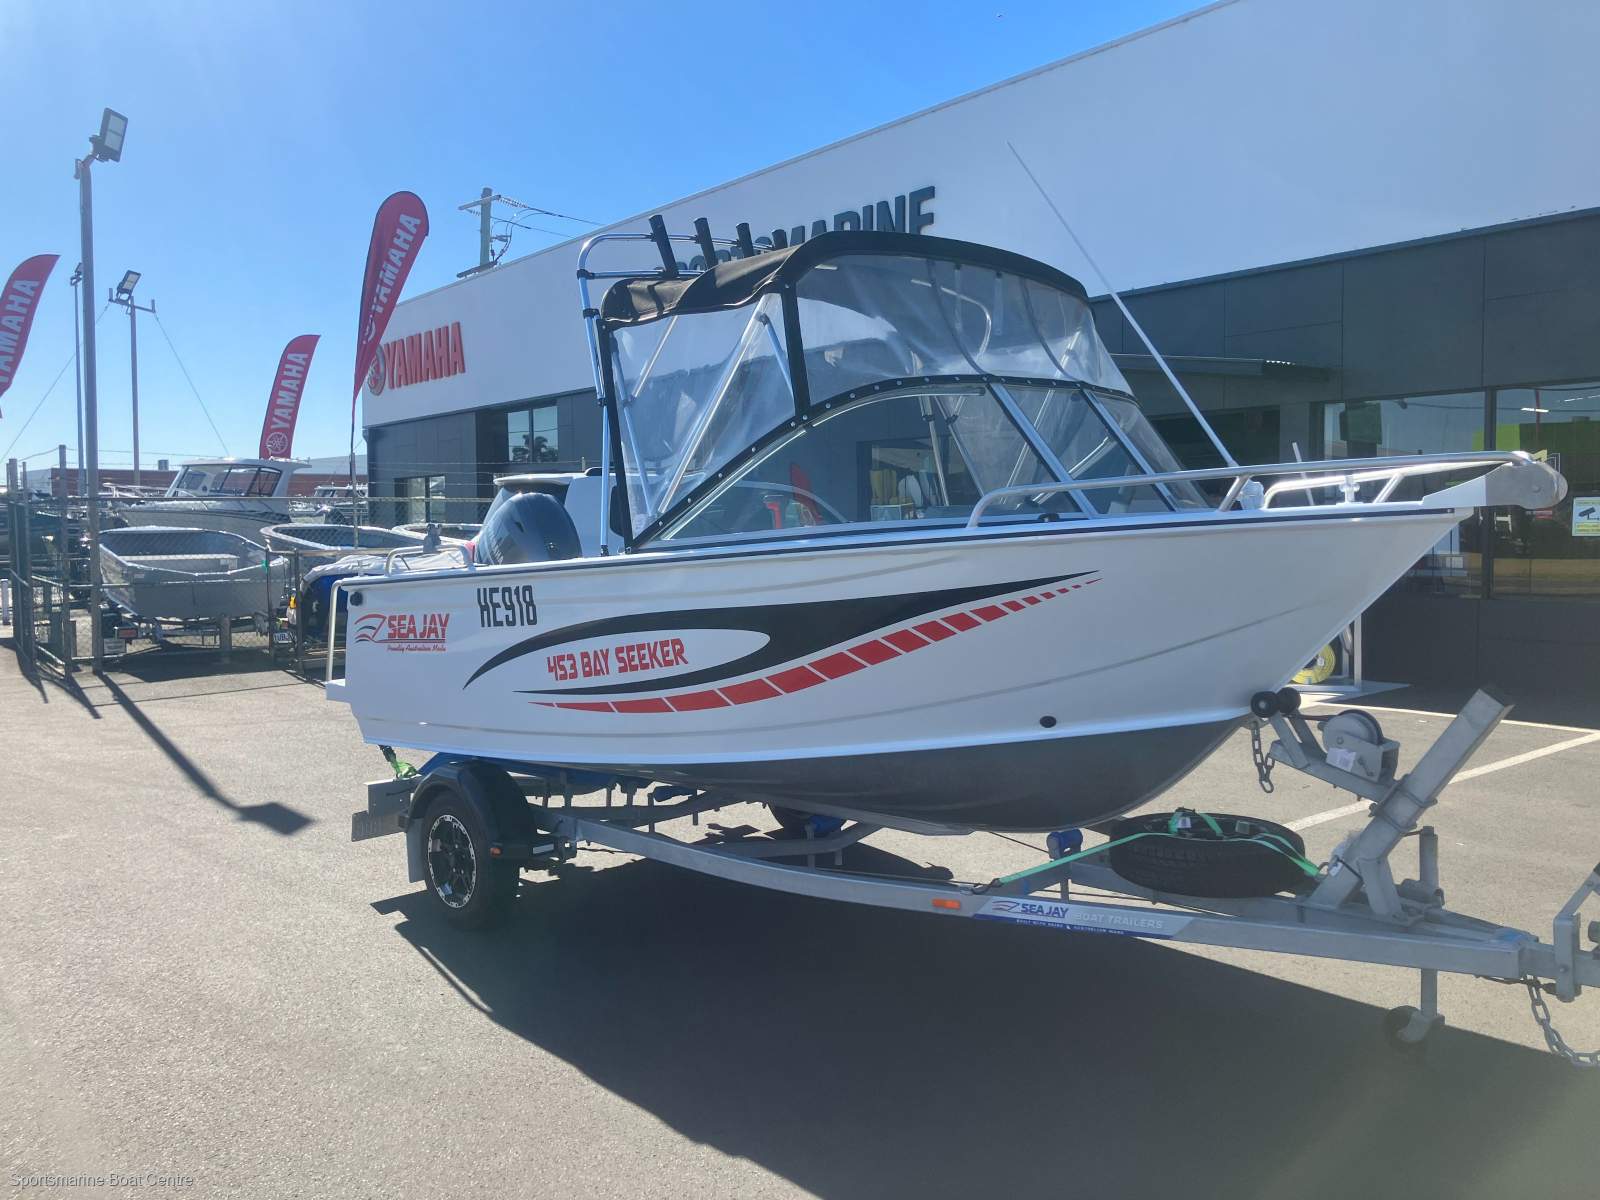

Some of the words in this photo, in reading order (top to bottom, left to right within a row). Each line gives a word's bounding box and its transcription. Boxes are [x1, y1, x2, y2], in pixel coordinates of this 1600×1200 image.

[384, 321, 466, 390] YAMAHA
[270, 352, 309, 430] YAMAHA
[477, 585, 538, 628] HE918
[547, 653, 578, 681] 453
[580, 648, 610, 678] BAY
[614, 638, 689, 674] SEEKER
[1108, 914, 1163, 929] TRAILERS
